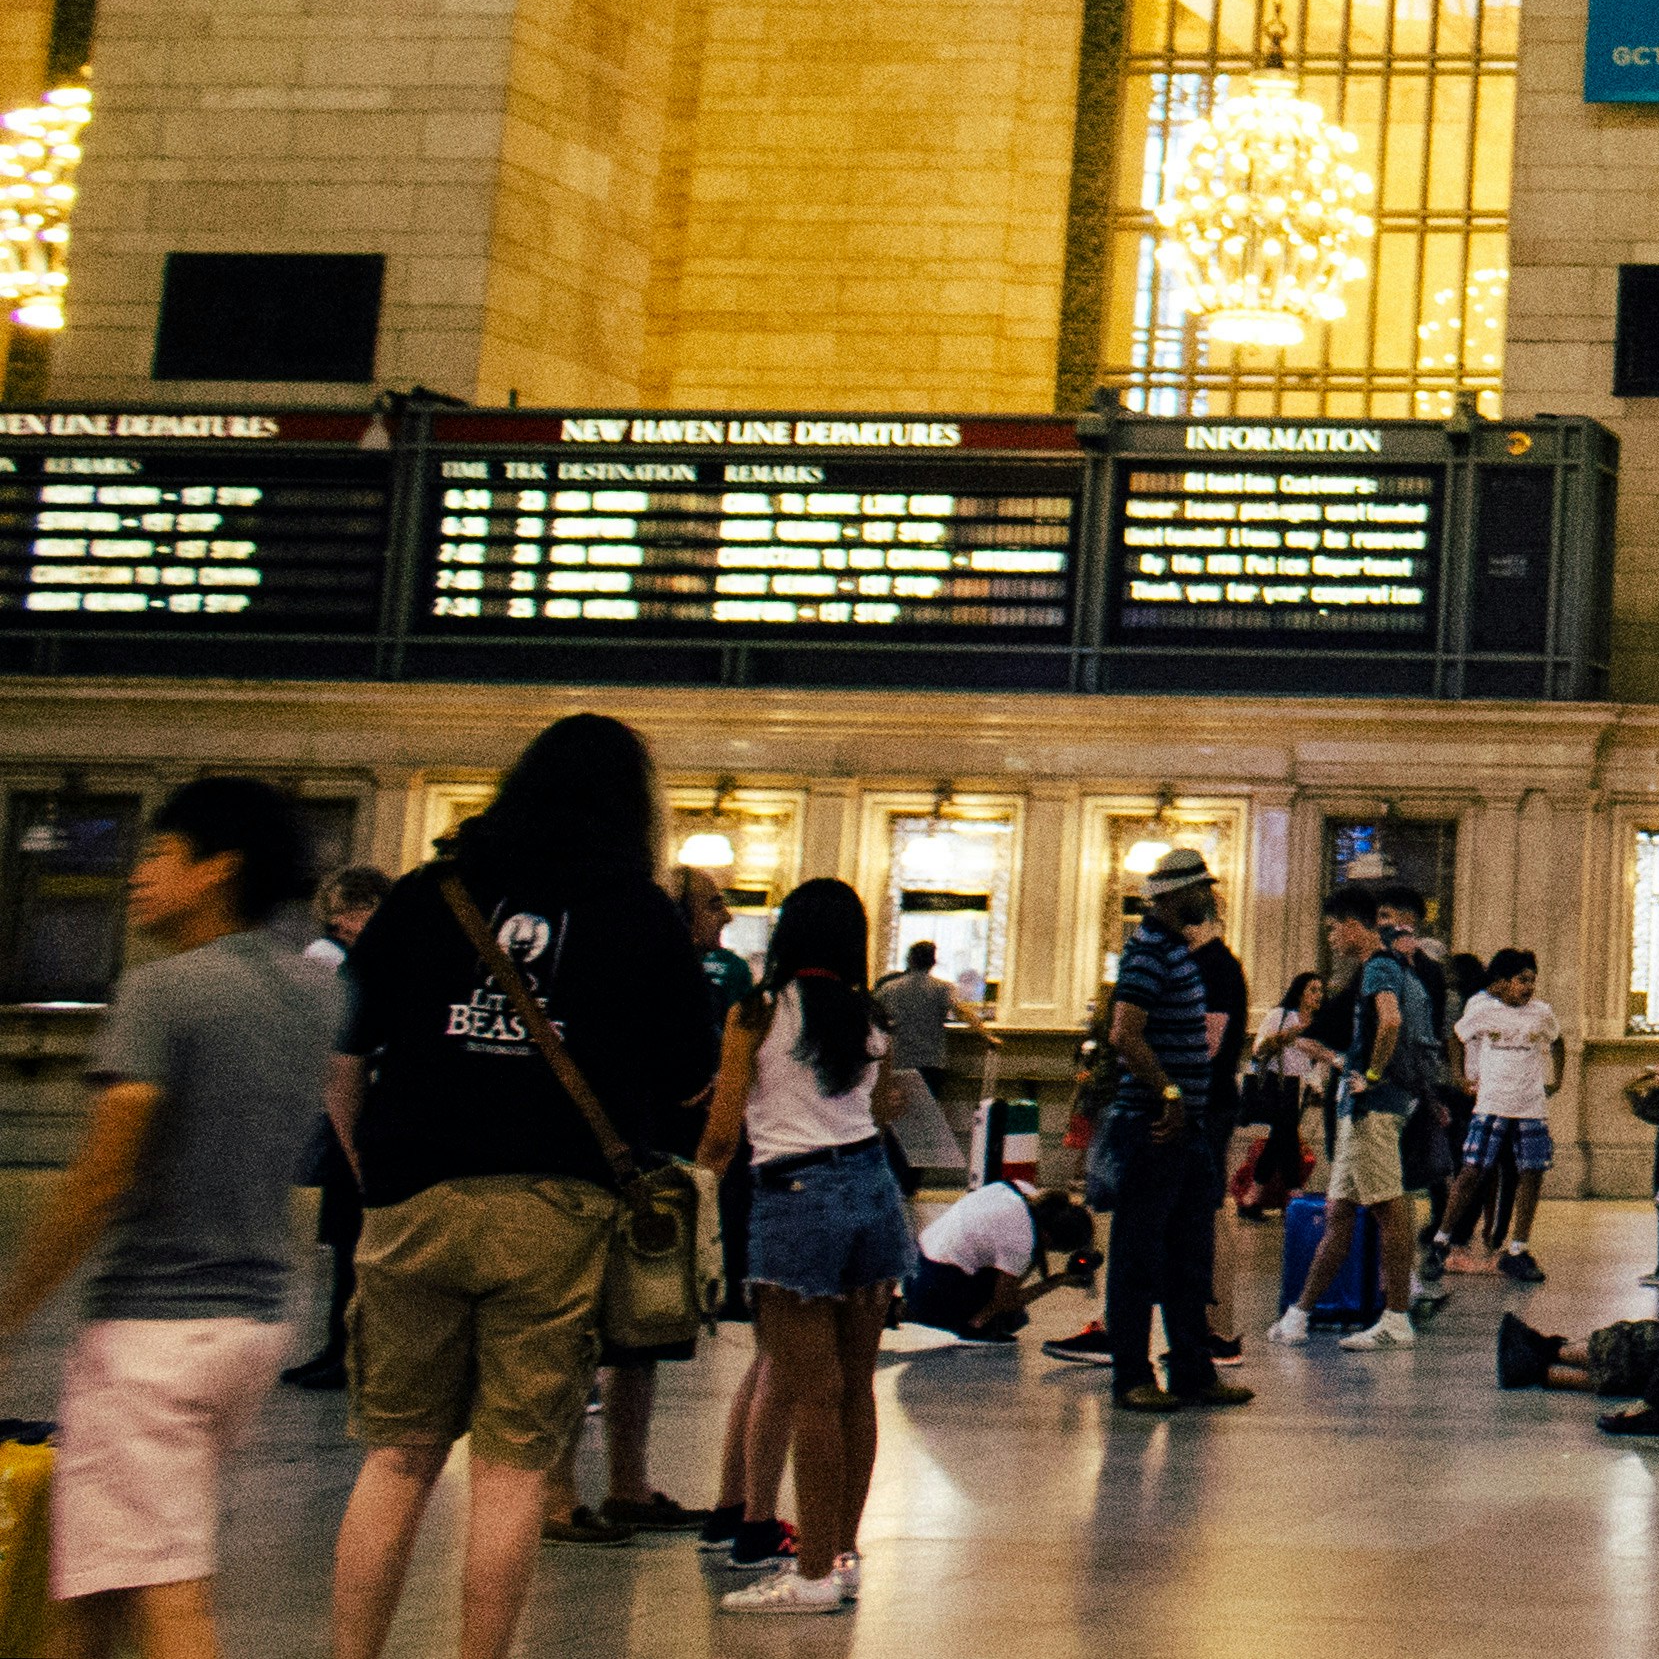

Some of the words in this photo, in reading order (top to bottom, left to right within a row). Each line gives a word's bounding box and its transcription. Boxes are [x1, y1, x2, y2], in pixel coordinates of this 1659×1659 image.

[50, 415, 111, 435] LINE
[115, 415, 280, 437] DEPARTURES
[560, 419, 629, 441] NEW
[630, 420, 723, 444] HAVEN
[727, 421, 791, 445] LINE
[795, 421, 961, 447] DEPARTURES
[1185, 426, 1381, 452] INFORMATION
[441, 462, 489, 479] TIME
[504, 462, 547, 479] TRK
[557, 463, 697, 481] DESTINATION
[723, 465, 825, 483] REMARKS
[445, 1004, 566, 1042] BEASS
